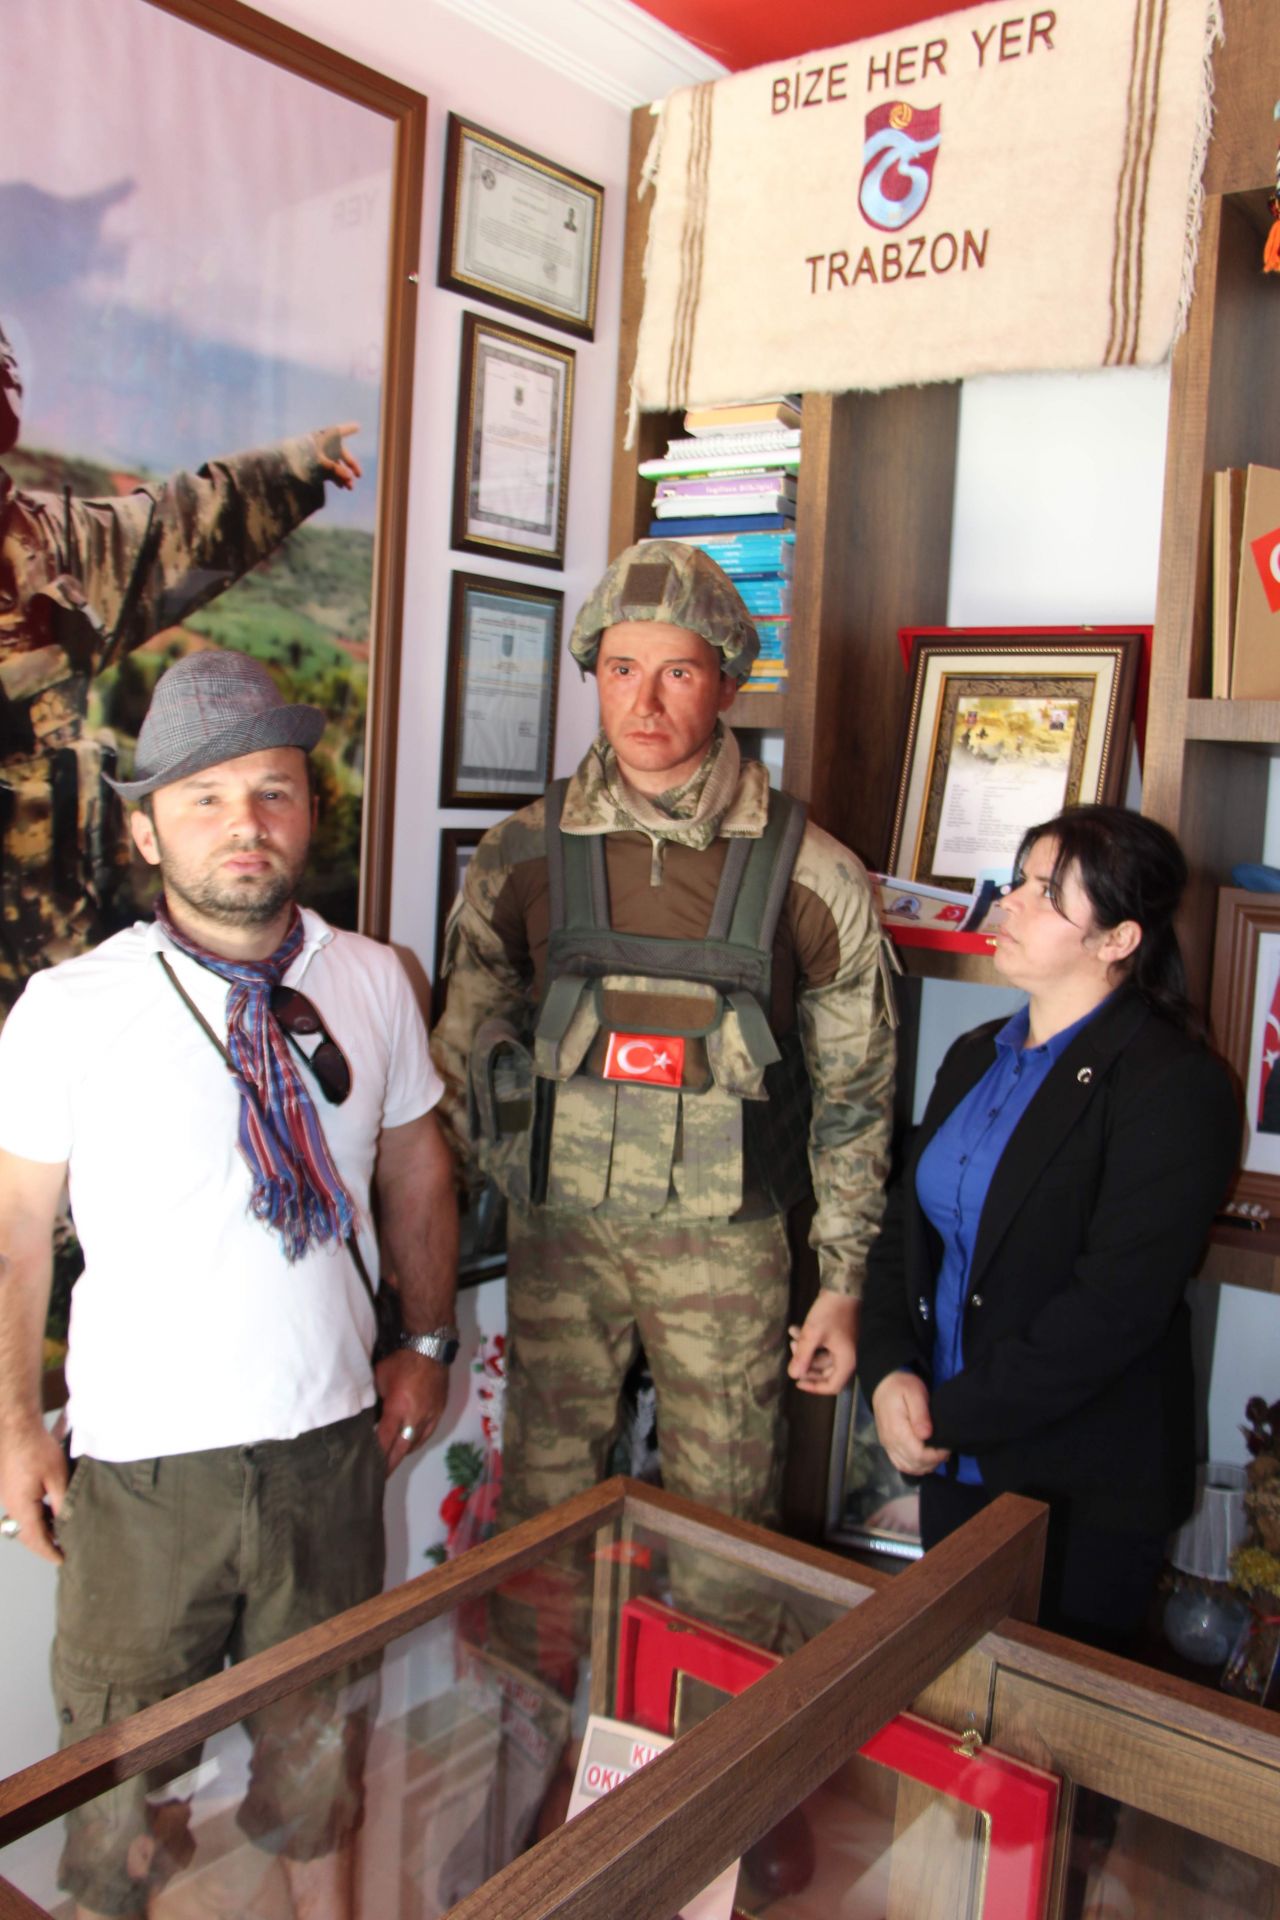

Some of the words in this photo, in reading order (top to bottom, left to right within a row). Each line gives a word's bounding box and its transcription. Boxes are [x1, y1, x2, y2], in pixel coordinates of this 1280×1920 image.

[771, 60, 848, 114] BİZE
[867, 38, 948, 92] HER
[972, 10, 1056, 68] YER
[805, 229, 989, 294] TRABZON
